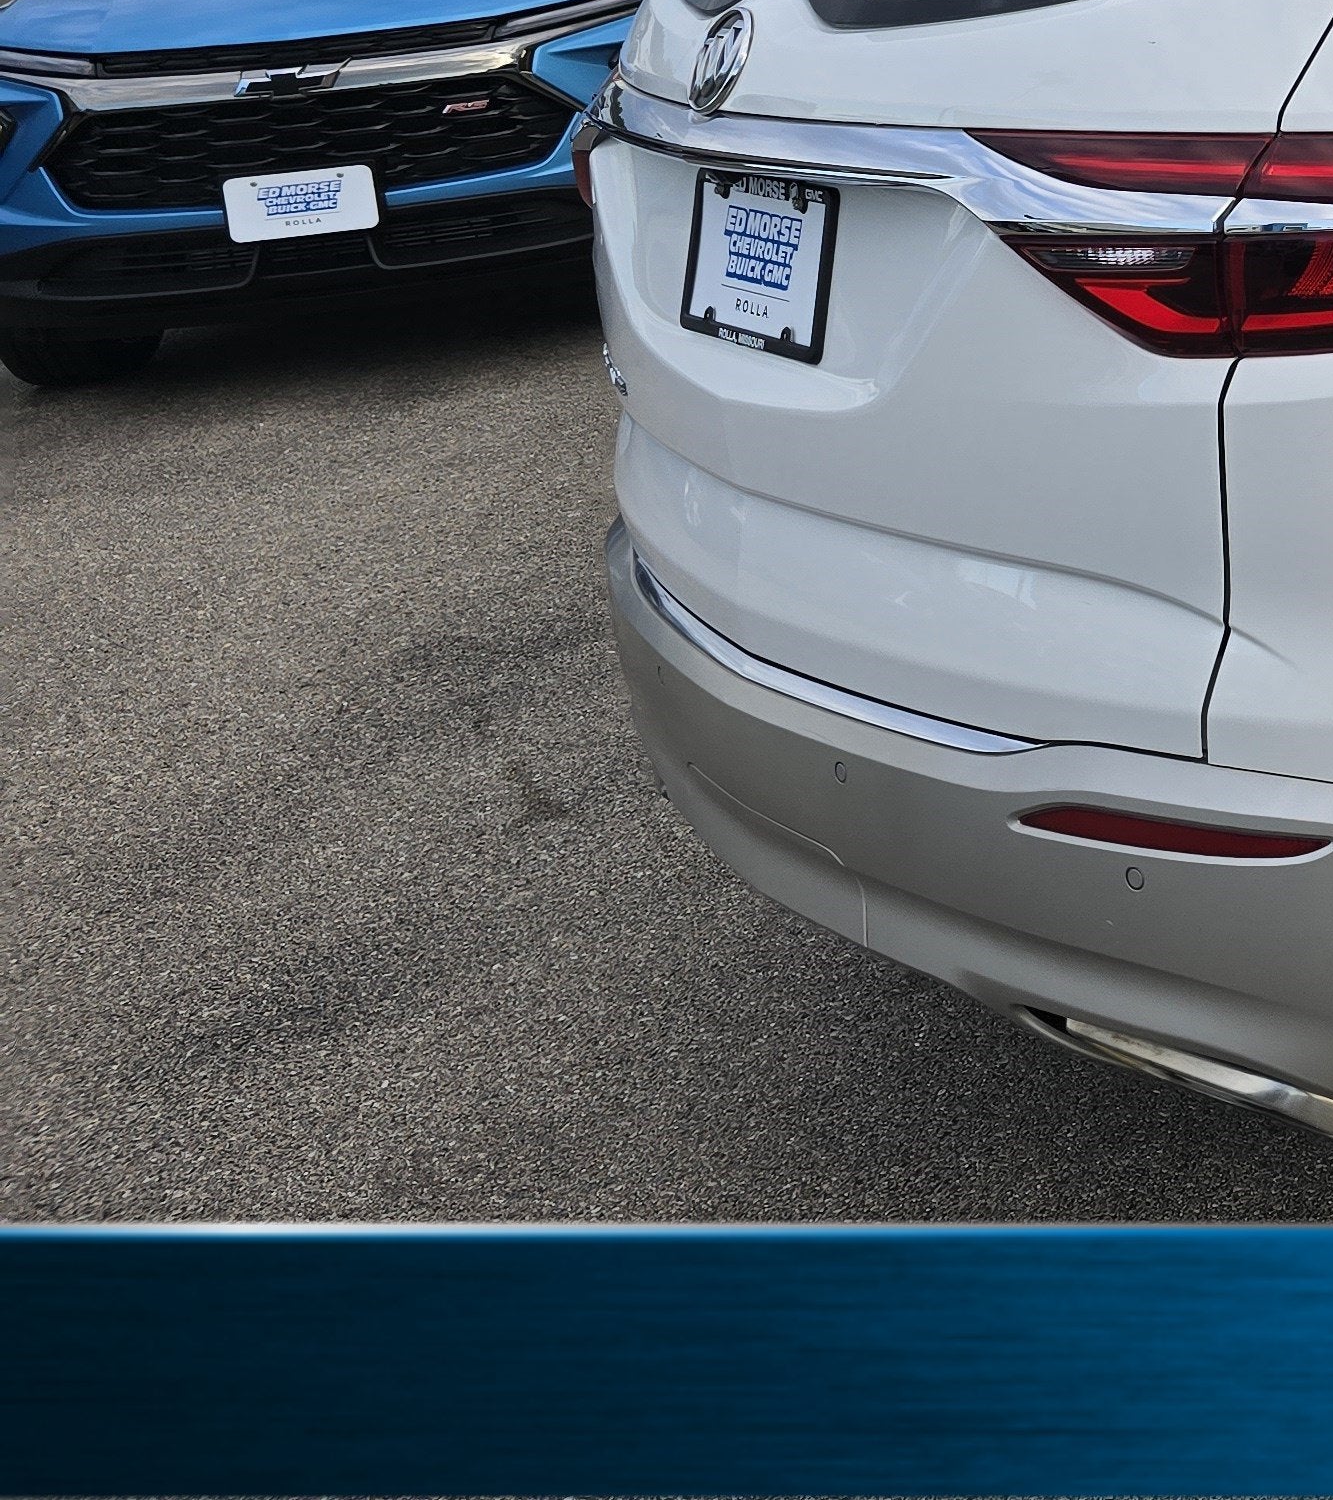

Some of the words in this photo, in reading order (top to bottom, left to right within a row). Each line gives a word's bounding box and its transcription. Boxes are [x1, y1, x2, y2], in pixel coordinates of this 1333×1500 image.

[442, 99, 490, 114] RS
[257, 186, 281, 200] ED
[281, 180, 341, 197] MORSE
[749, 176, 786, 200] MORSE
[805, 188, 823, 202] GMC
[265, 192, 337, 207] CHEVROLET
[285, 217, 322, 227] ROLLA
[725, 206, 749, 233] ED
[749, 211, 802, 245] MORSE
[729, 233, 794, 265] CHEVROLET
[735, 298, 769, 318] ROLLA
